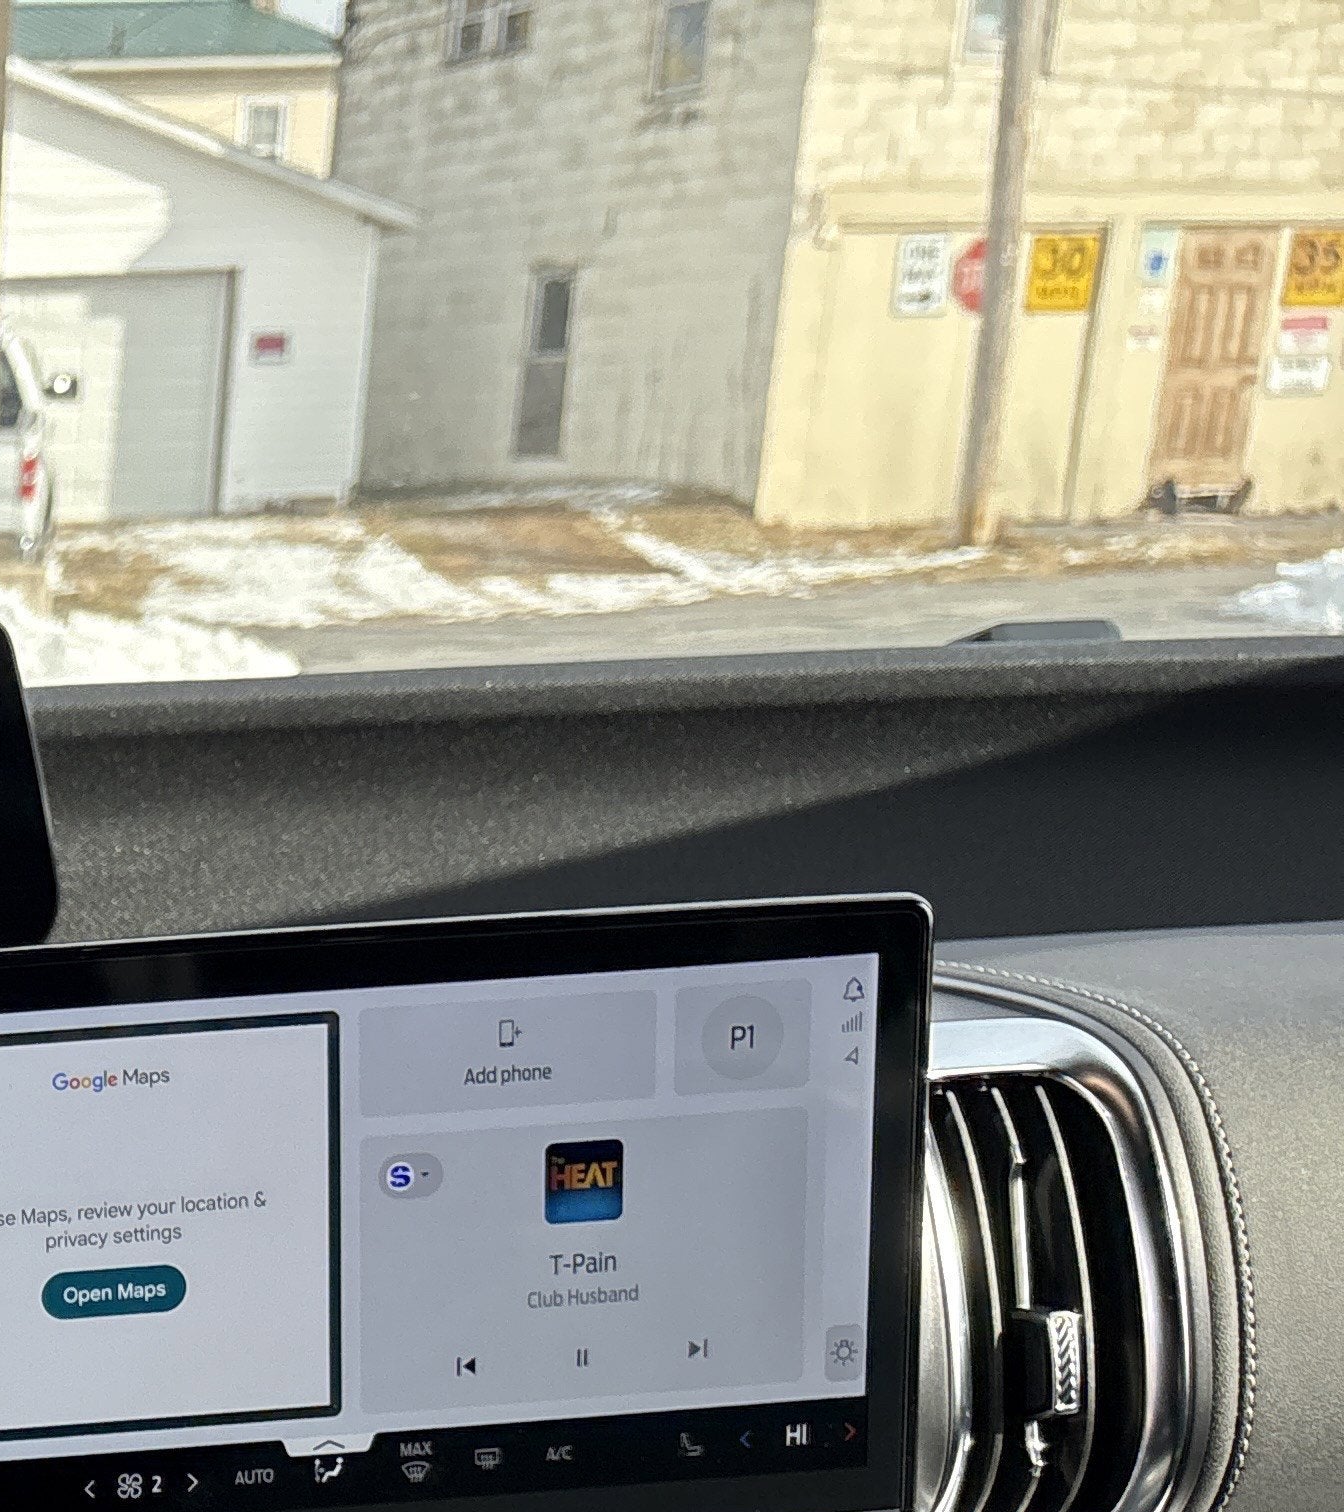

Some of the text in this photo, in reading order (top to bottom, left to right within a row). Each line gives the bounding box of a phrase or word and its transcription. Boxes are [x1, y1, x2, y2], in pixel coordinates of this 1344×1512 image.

[729, 1024, 756, 1050] P1
[50, 1066, 172, 1093] Google Maps
[463, 1062, 553, 1086] Add phone
[549, 1160, 619, 1191] HEAT
[20, 1205, 72, 1227] Maps,
[76, 1200, 133, 1222] review
[136, 1198, 176, 1220] your
[179, 1192, 250, 1214] location
[253, 1191, 268, 1209] &
[44, 1222, 183, 1252] privacy settings
[549, 1251, 619, 1276] T-Pain
[61, 1280, 168, 1308] Open Maps
[527, 1284, 641, 1309] Club Husband
[785, 1423, 809, 1448] HI
[398, 1440, 433, 1457] MAX
[545, 1444, 574, 1462] A/C
[150, 1475, 163, 1494] 2
[233, 1466, 276, 1487] AUTO
